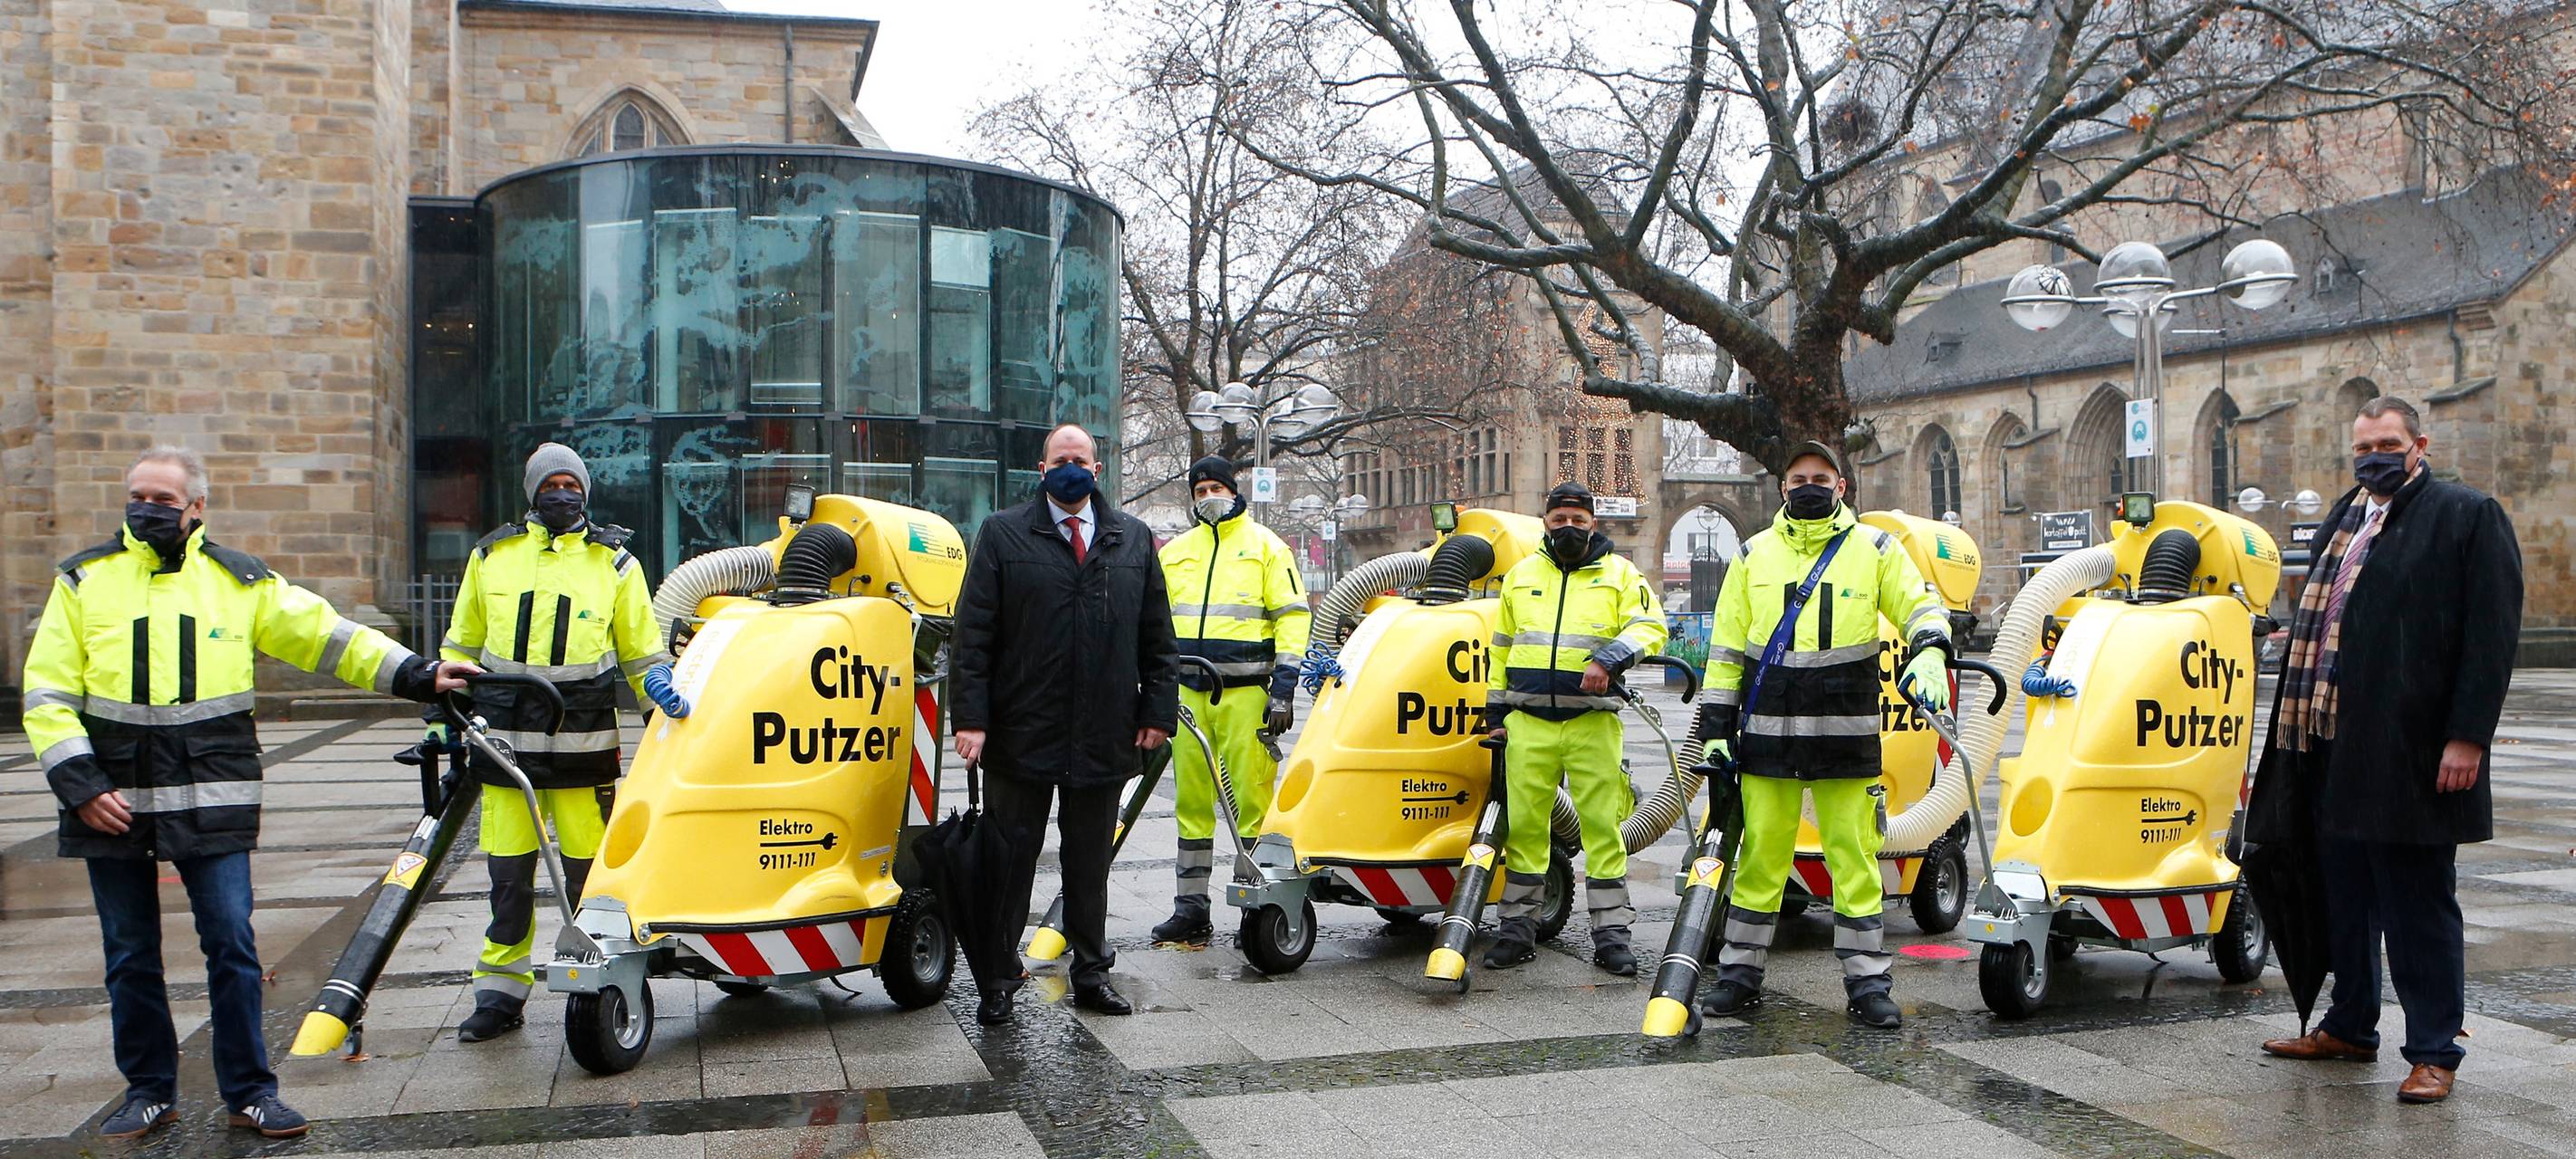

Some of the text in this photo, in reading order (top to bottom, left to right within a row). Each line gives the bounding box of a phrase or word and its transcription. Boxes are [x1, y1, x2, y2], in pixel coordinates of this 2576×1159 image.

[947, 547, 963, 560] EDG
[1964, 554, 1976, 566] EDG
[1447, 638, 1491, 684] Cit
[811, 645, 901, 715] City-
[2180, 639, 2244, 704] City-
[1398, 692, 1490, 736] Putz
[2136, 699, 2244, 748] Putzer
[753, 712, 901, 764] Putzer
[1401, 779, 1447, 792] Elektro
[1401, 806, 1450, 820] 9111-111
[2141, 797, 2181, 812] Elektro
[760, 819, 813, 836] Elektro
[2140, 828, 2182, 844] 9111-111
[759, 852, 816, 870] 9111-111
